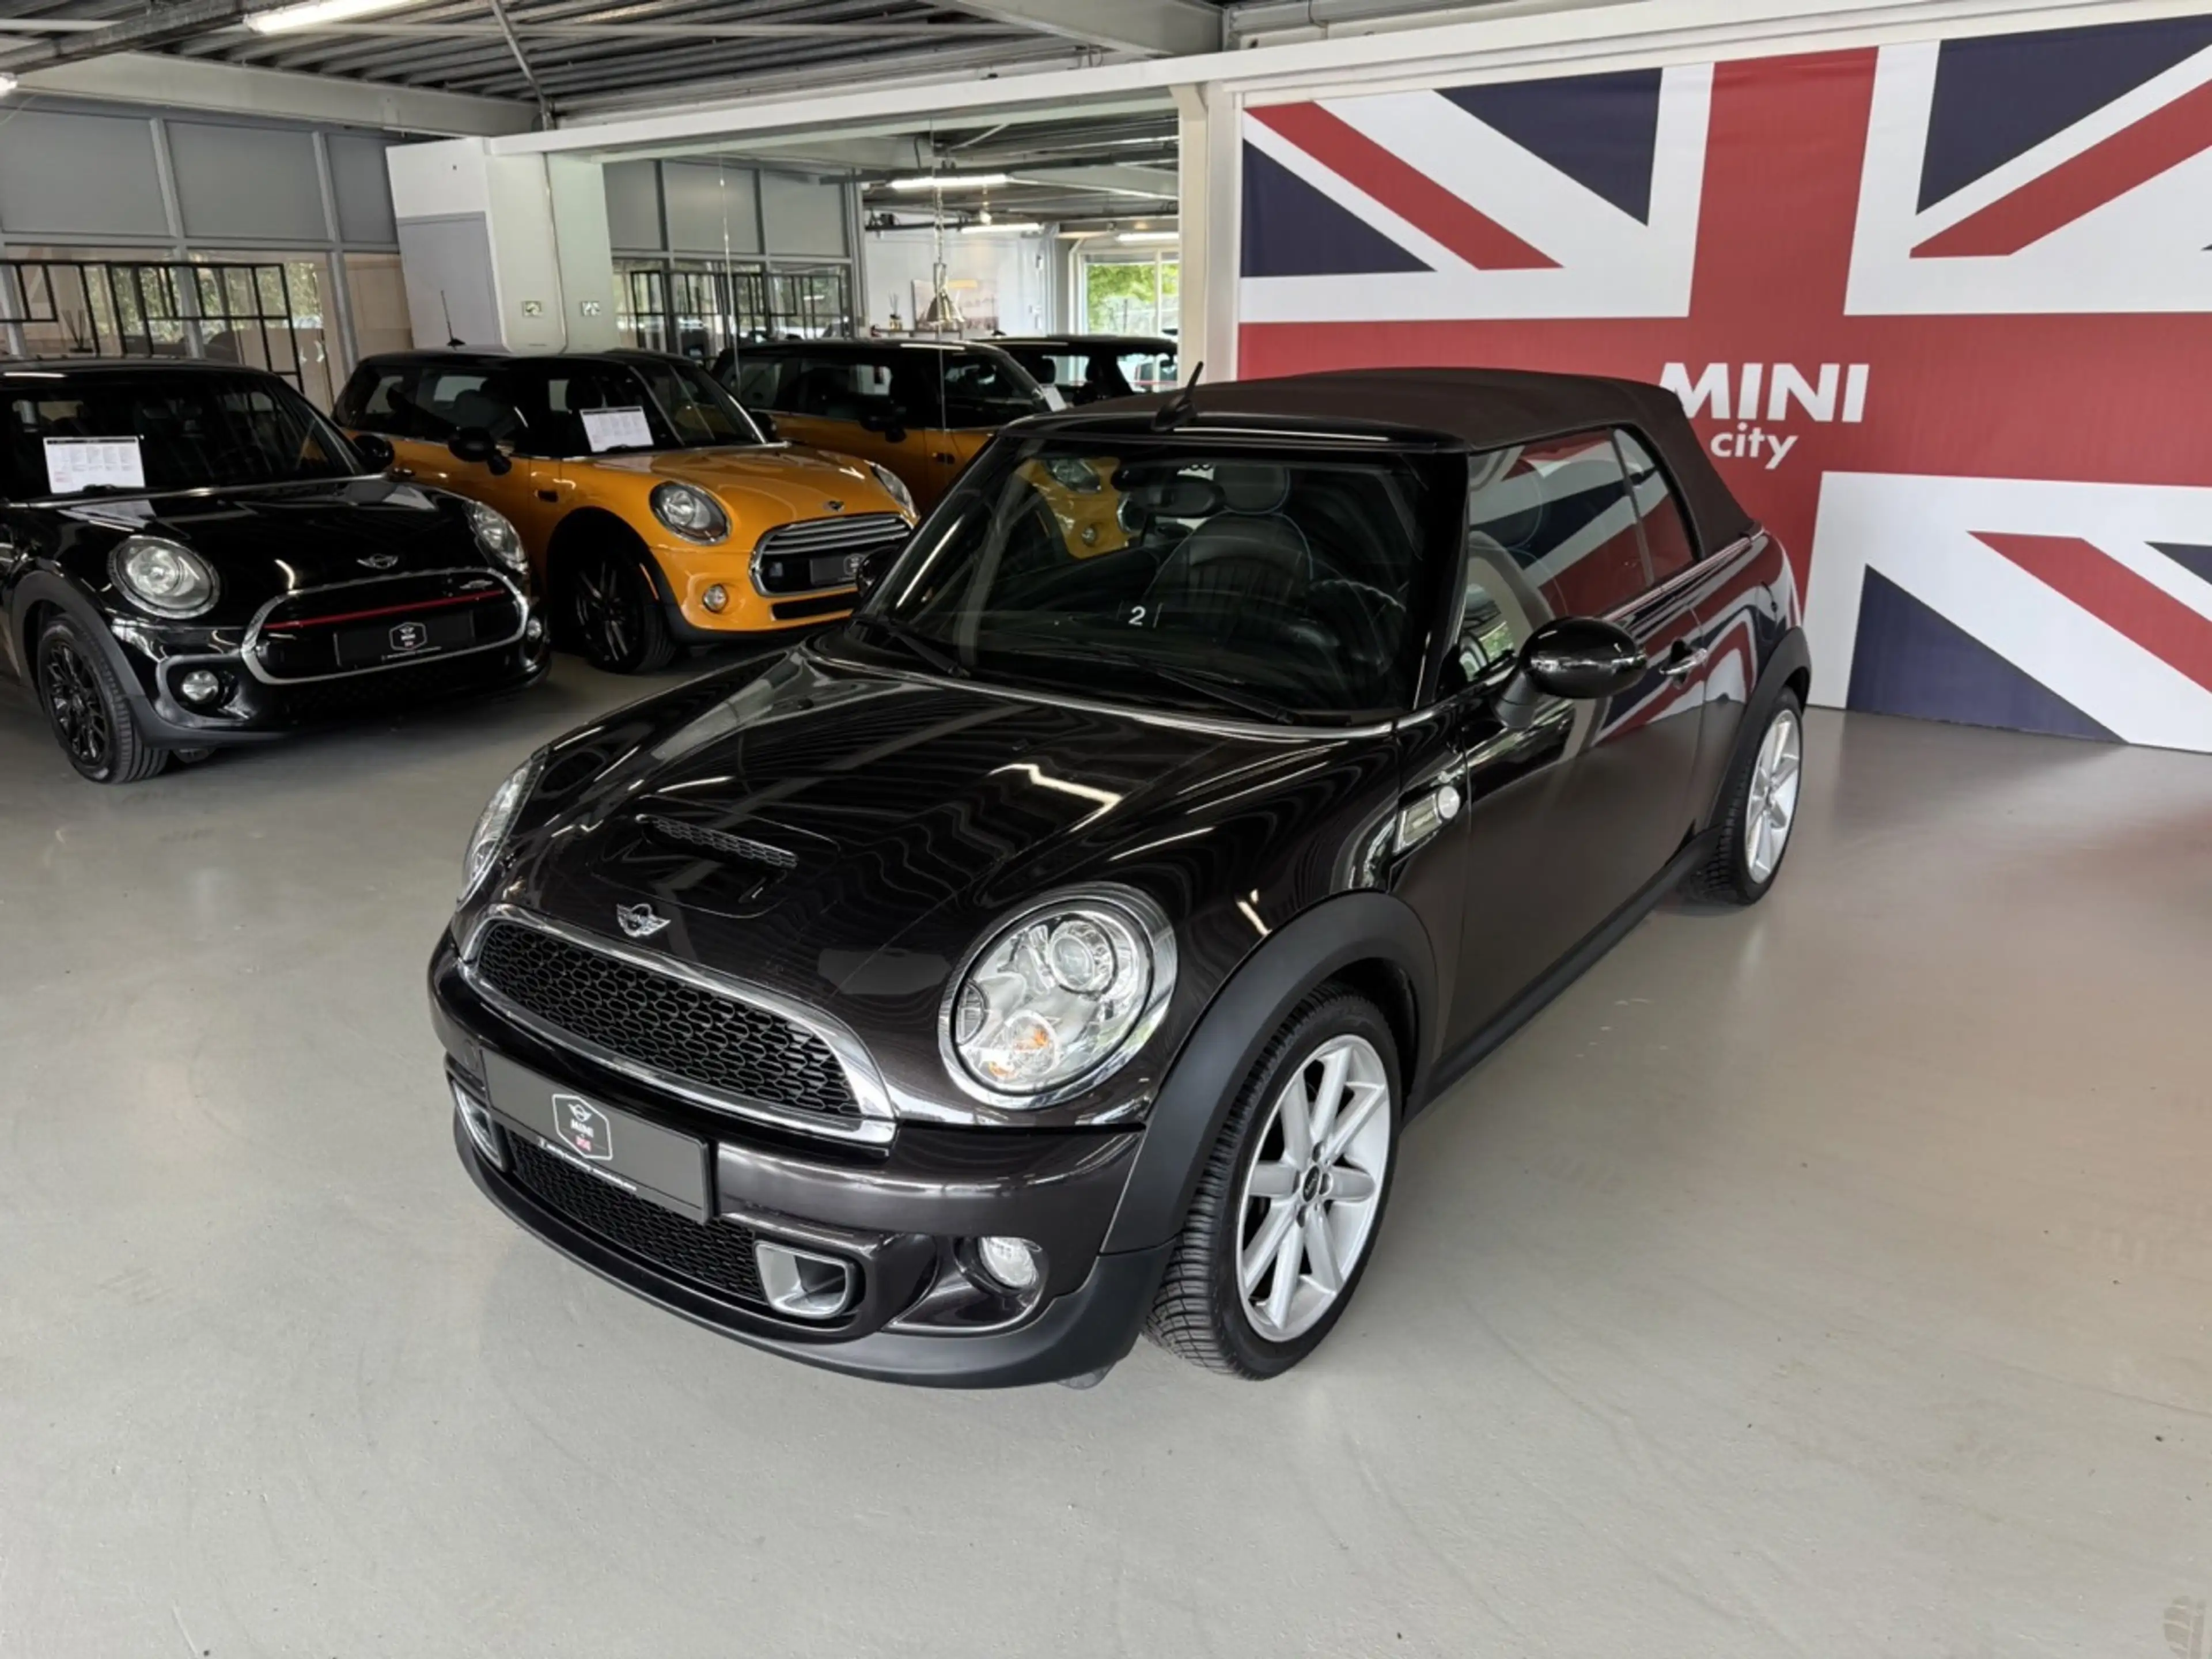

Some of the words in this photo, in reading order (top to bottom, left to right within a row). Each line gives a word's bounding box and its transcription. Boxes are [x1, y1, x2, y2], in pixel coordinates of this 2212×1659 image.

[1660, 362, 1870, 422] MINI
[1710, 422, 1799, 469] city
[1128, 605, 1146, 626] 2
